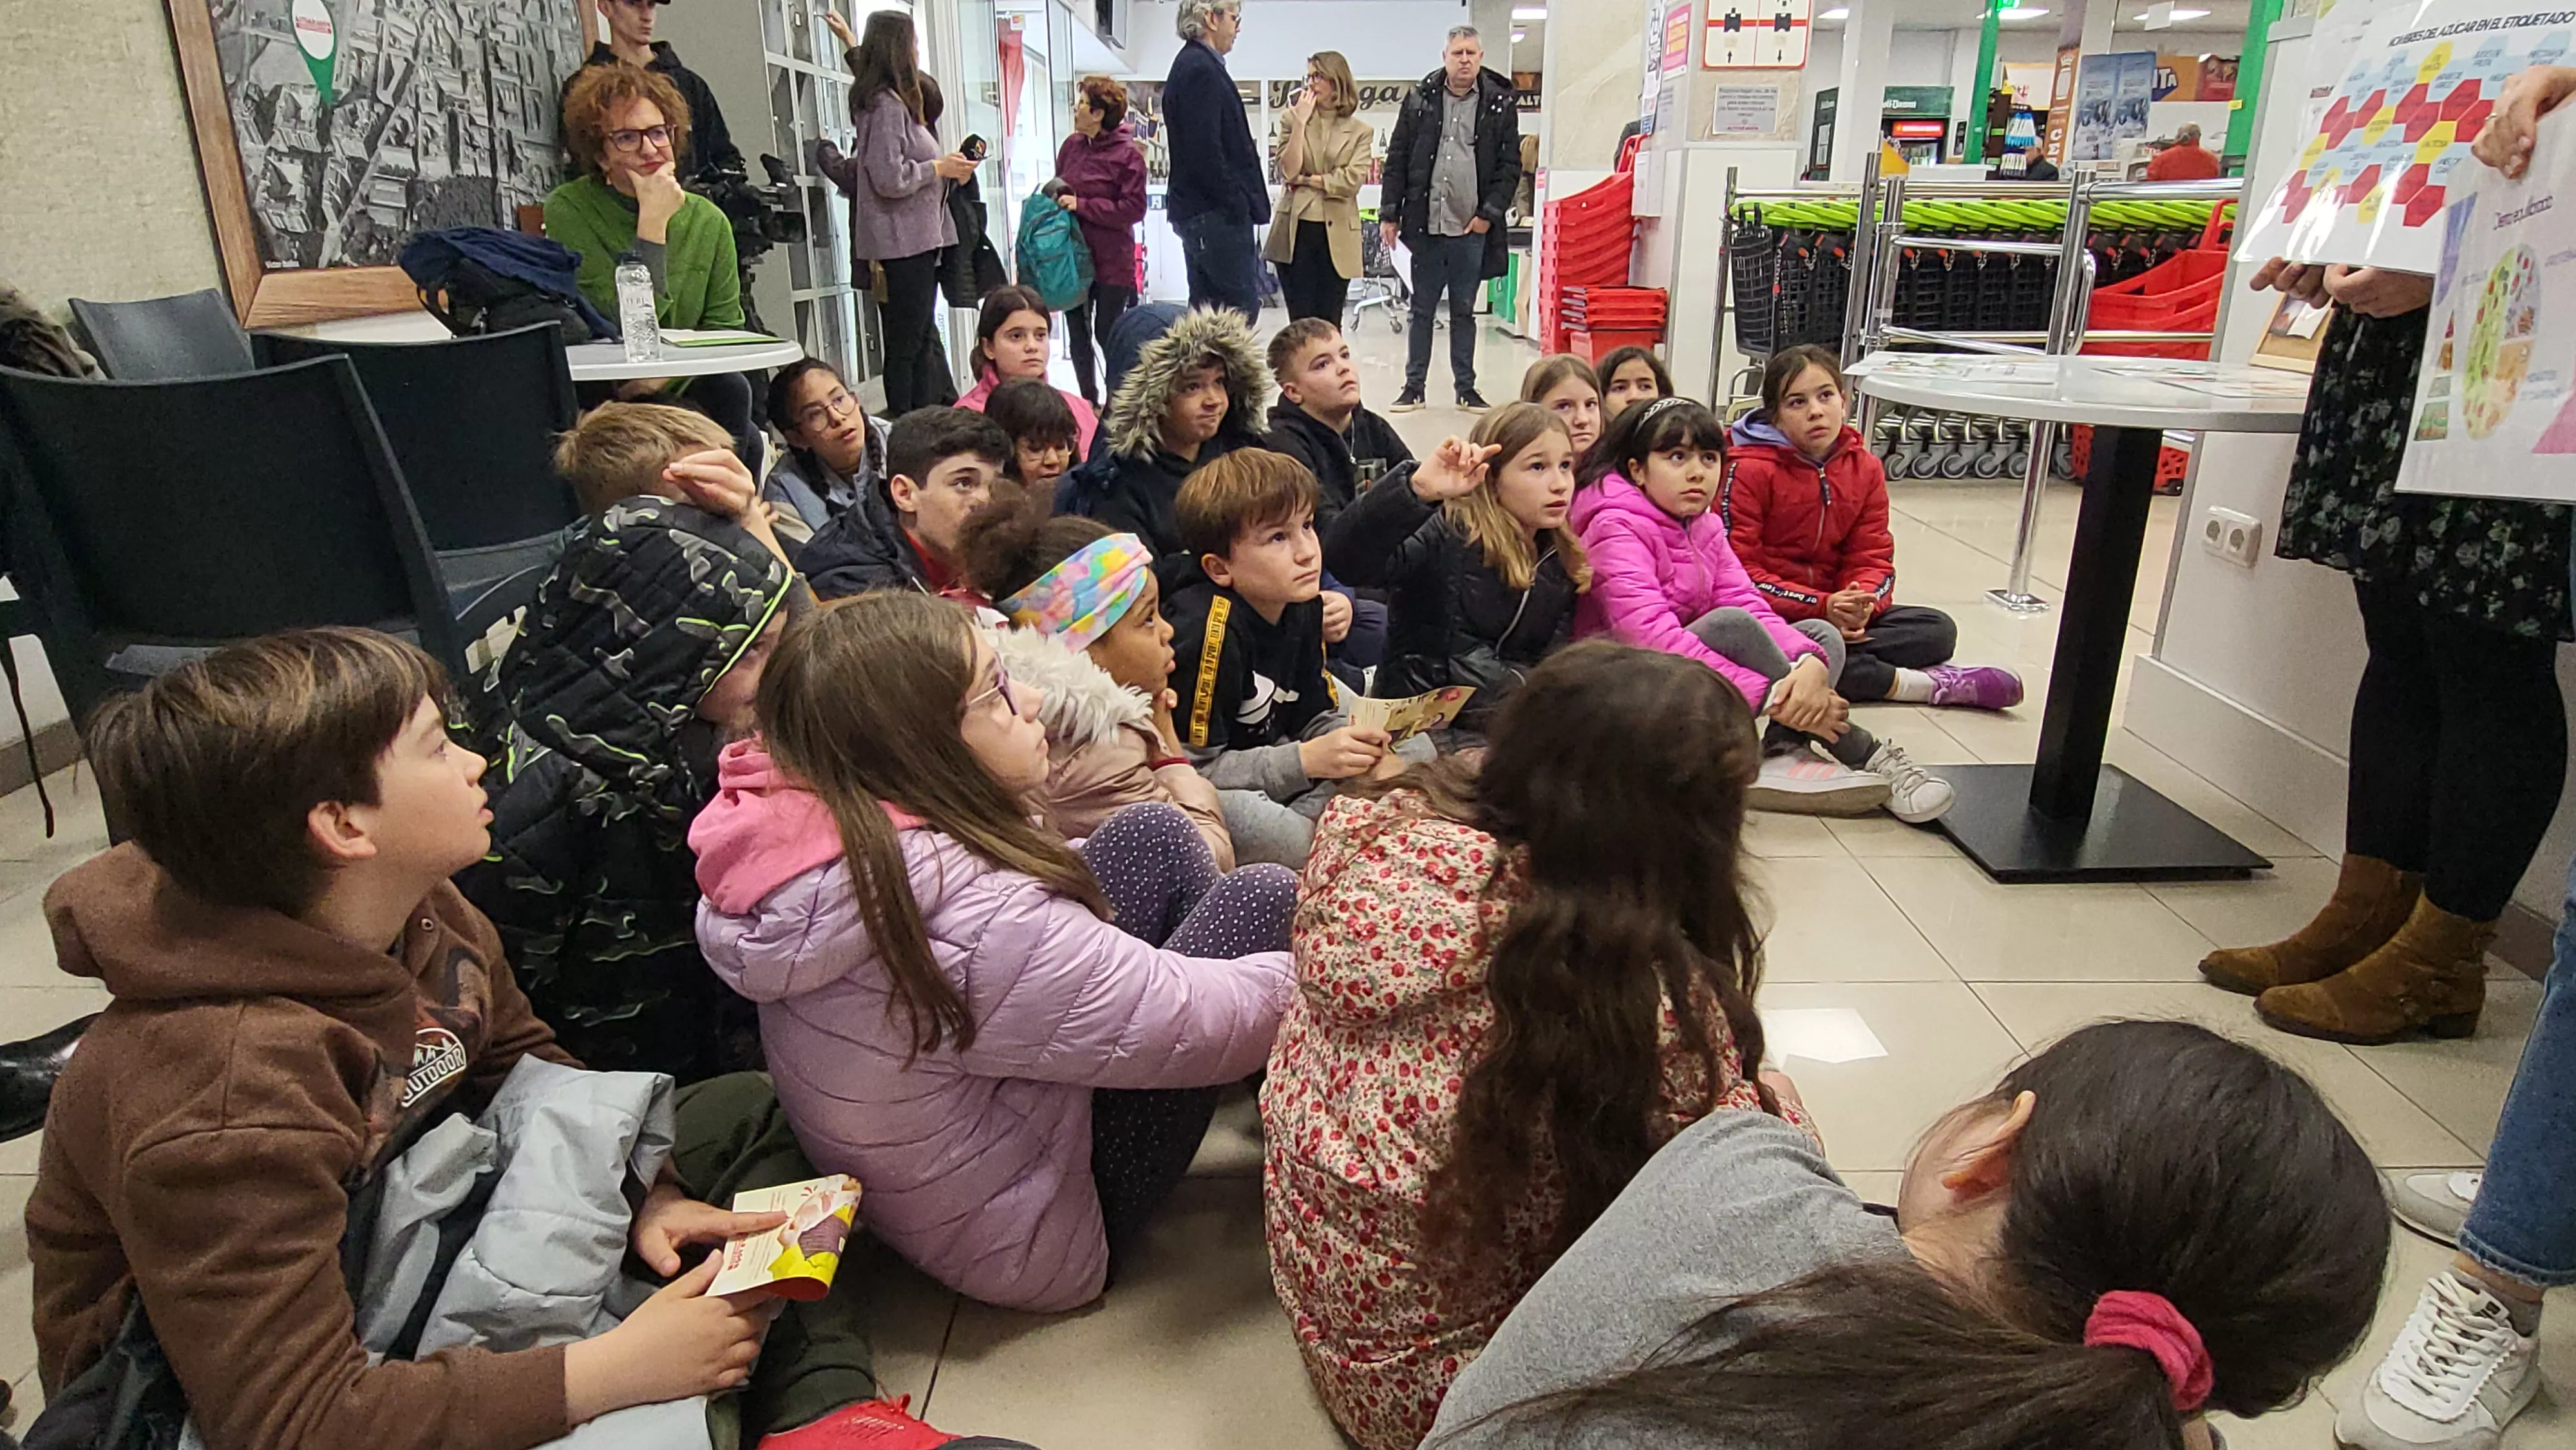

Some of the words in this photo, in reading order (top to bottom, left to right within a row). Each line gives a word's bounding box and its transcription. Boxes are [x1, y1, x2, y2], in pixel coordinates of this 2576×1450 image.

[2422, 27, 2440, 40] DEL
[2475, 19, 2492, 31] EN
[2501, 10, 2575, 29] ETIQUETADO
[2152, 68, 2177, 89] ITA
